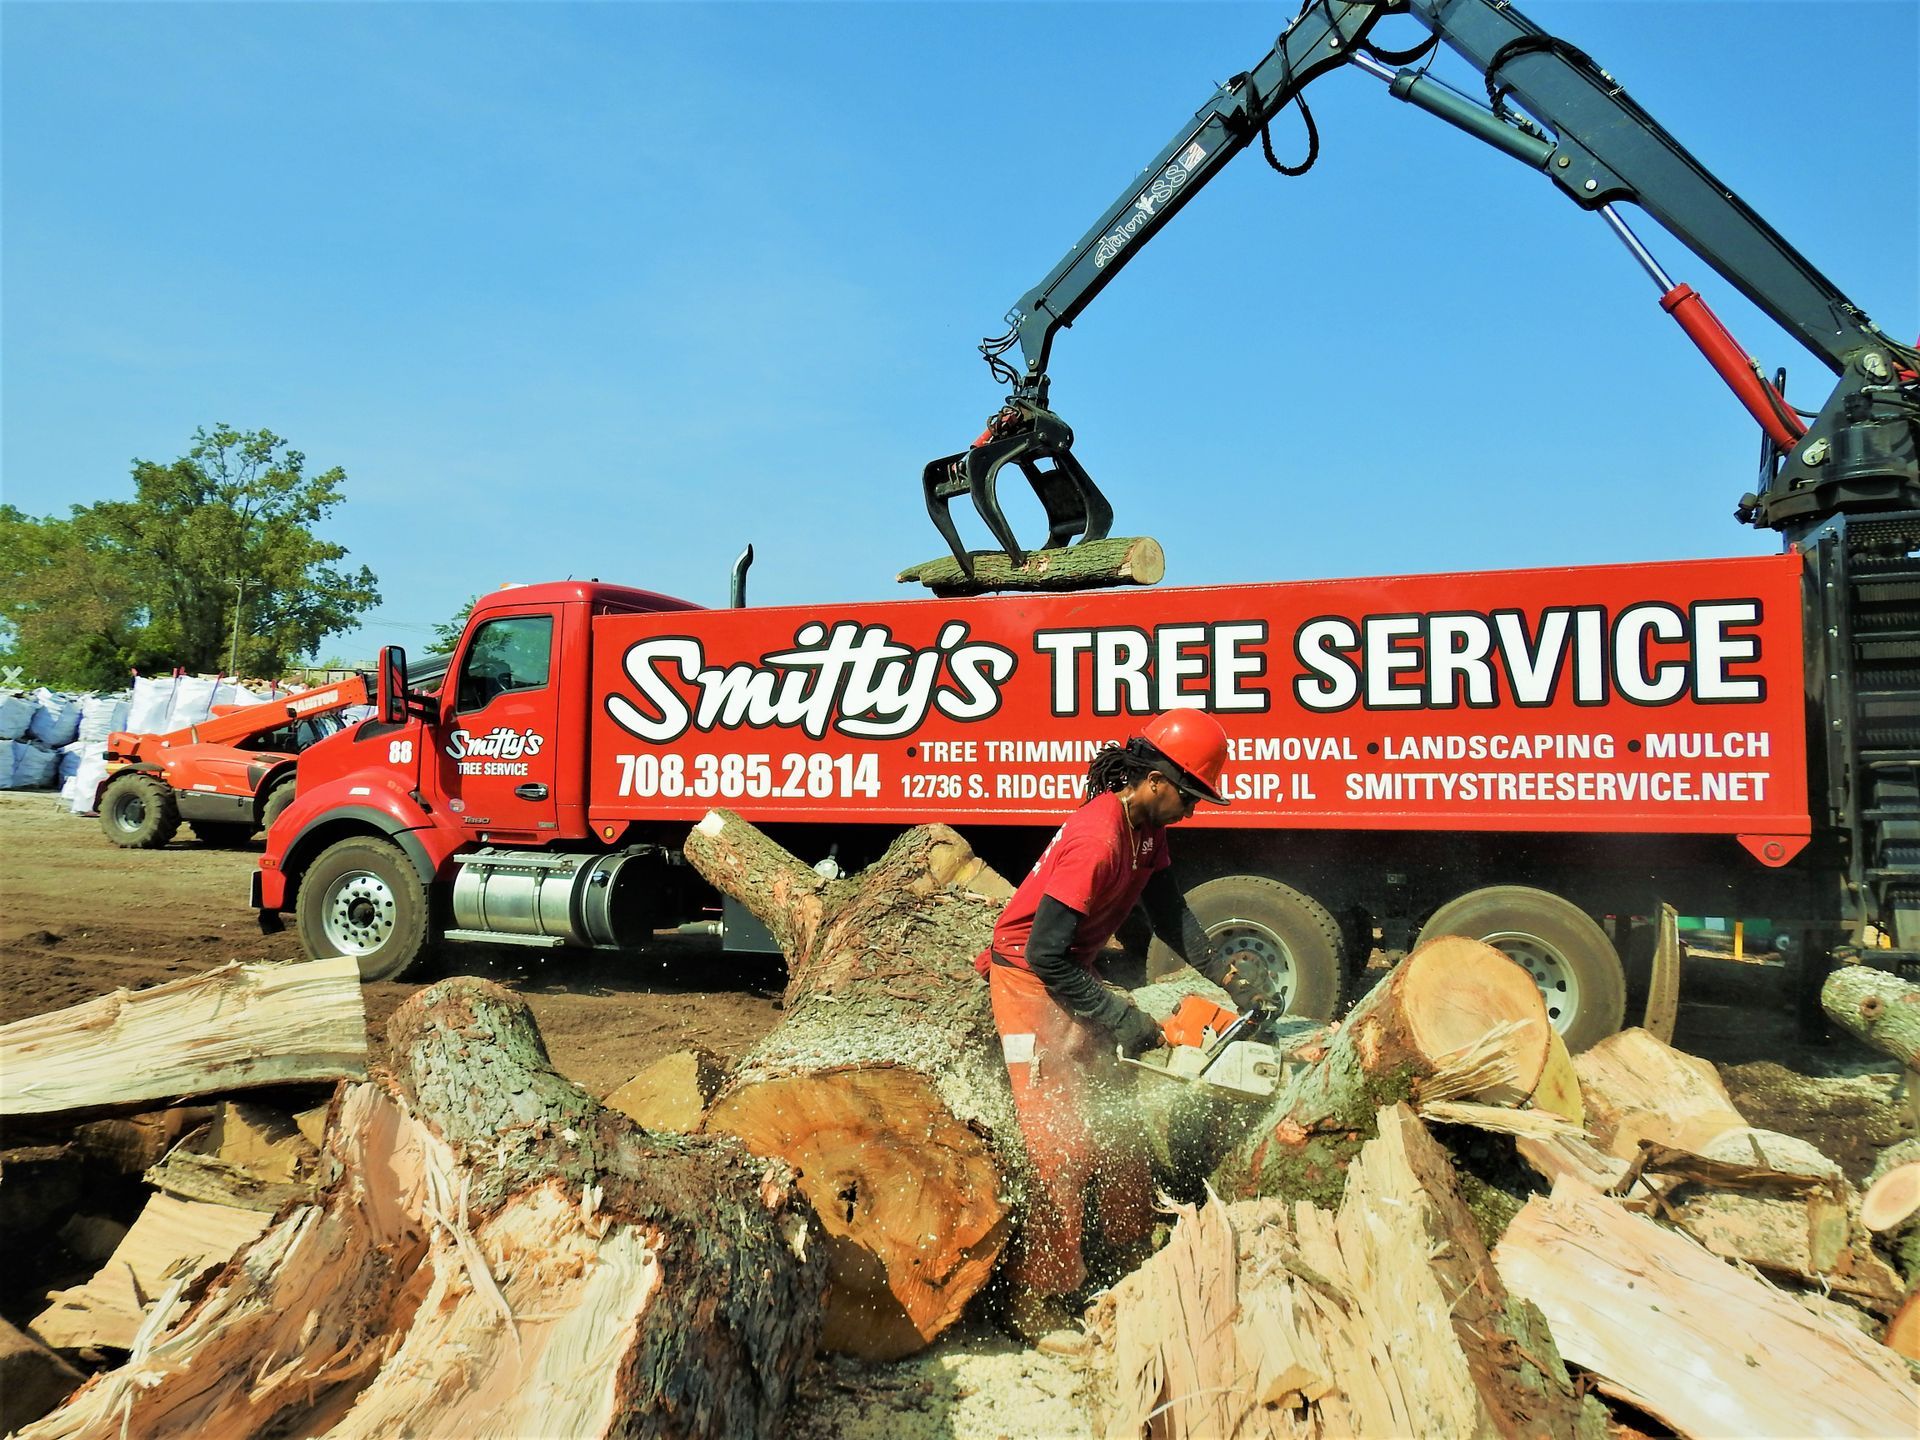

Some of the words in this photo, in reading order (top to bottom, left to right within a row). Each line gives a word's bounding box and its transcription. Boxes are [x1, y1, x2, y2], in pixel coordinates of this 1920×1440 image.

[606, 621, 1016, 743] Smitty's
[1034, 621, 1268, 716] TREE
[1294, 599, 1765, 710] SERVICE
[388, 740, 413, 764] 88
[445, 727, 545, 760] Smitty's
[919, 741, 979, 763] TREE
[1383, 733, 1615, 760] LANDSCAPING
[1645, 732, 1771, 758] MULCH
[457, 762, 483, 775] TREE
[484, 762, 529, 776] SERVICE
[616, 752, 882, 798] 708.385.2814
[901, 774, 962, 799] 12736
[968, 773, 991, 799] S.
[1215, 773, 1285, 803] LSIP,
[1291, 773, 1316, 800] IL
[1345, 772, 1770, 801] SMITTYSTREESERVICE.NET
